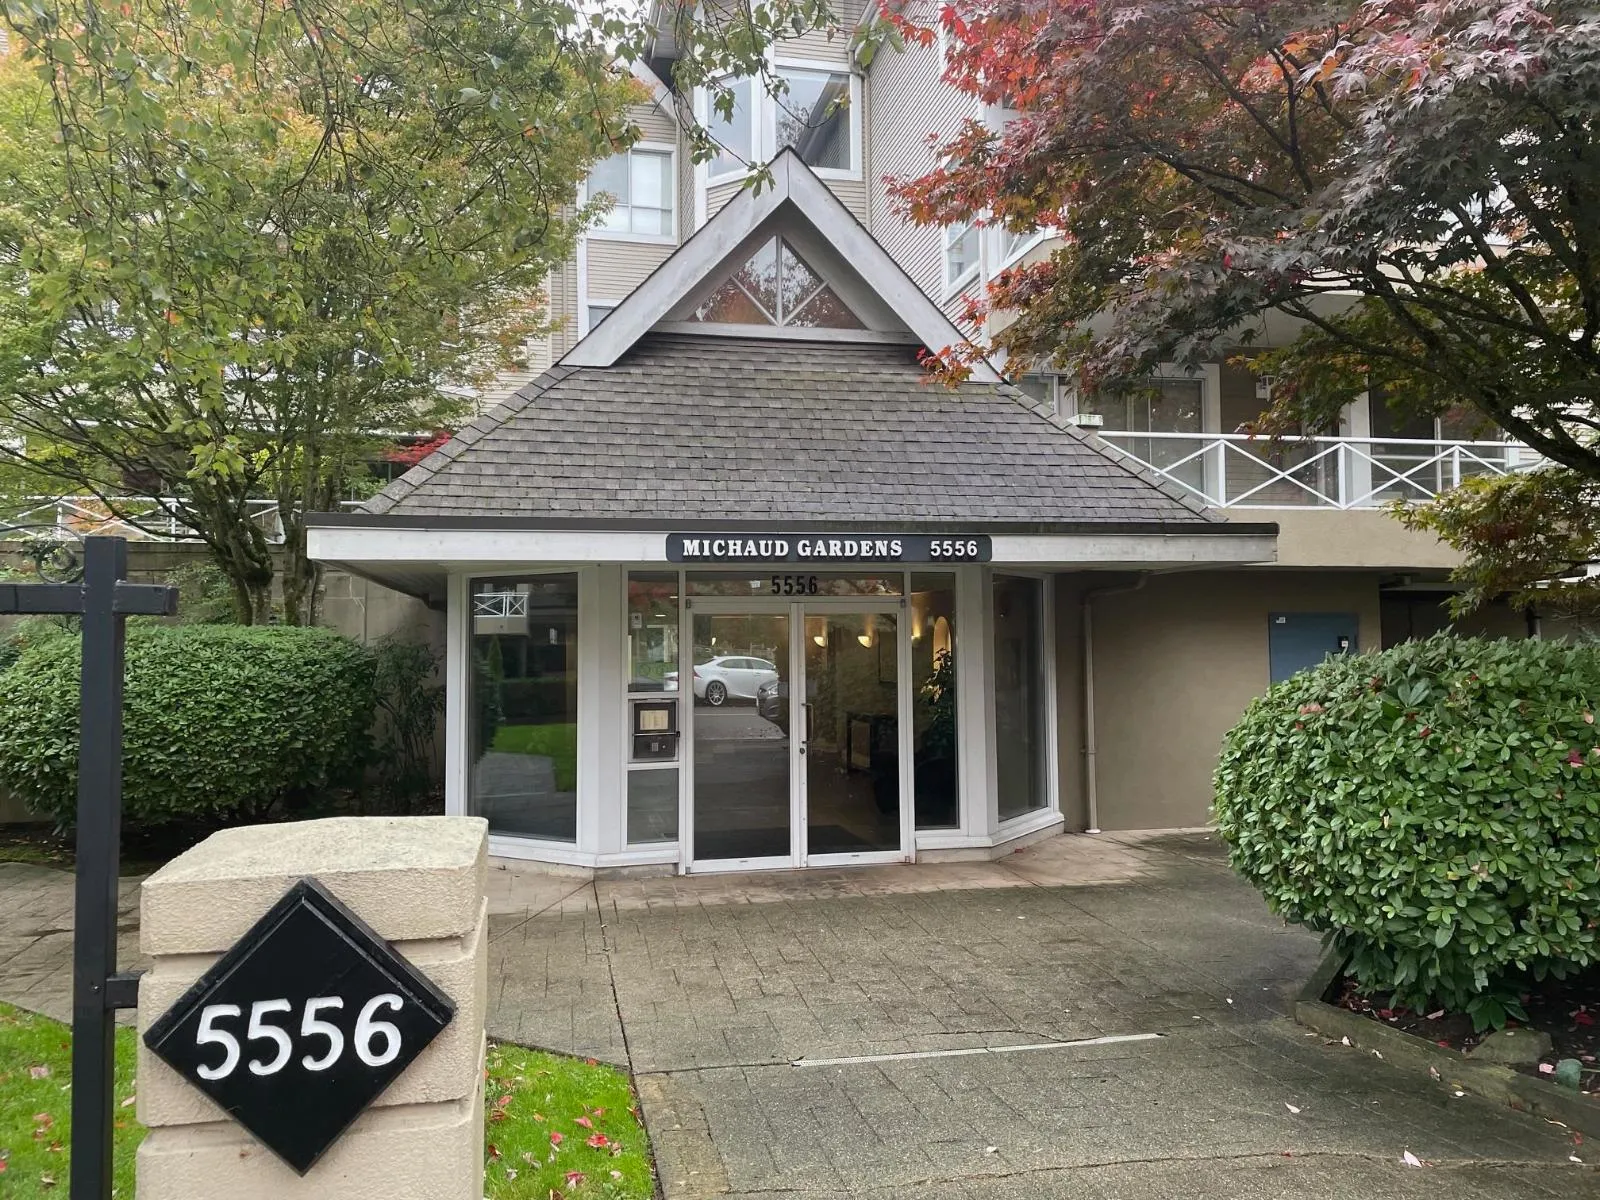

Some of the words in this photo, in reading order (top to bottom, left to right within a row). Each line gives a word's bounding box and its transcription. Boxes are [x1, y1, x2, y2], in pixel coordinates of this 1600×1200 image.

[682, 539, 789, 557] MICHAUD
[797, 539, 903, 557] GARDENS
[930, 540, 979, 557] 5556
[771, 575, 818, 596] 5556
[196, 993, 404, 1081] 5556
